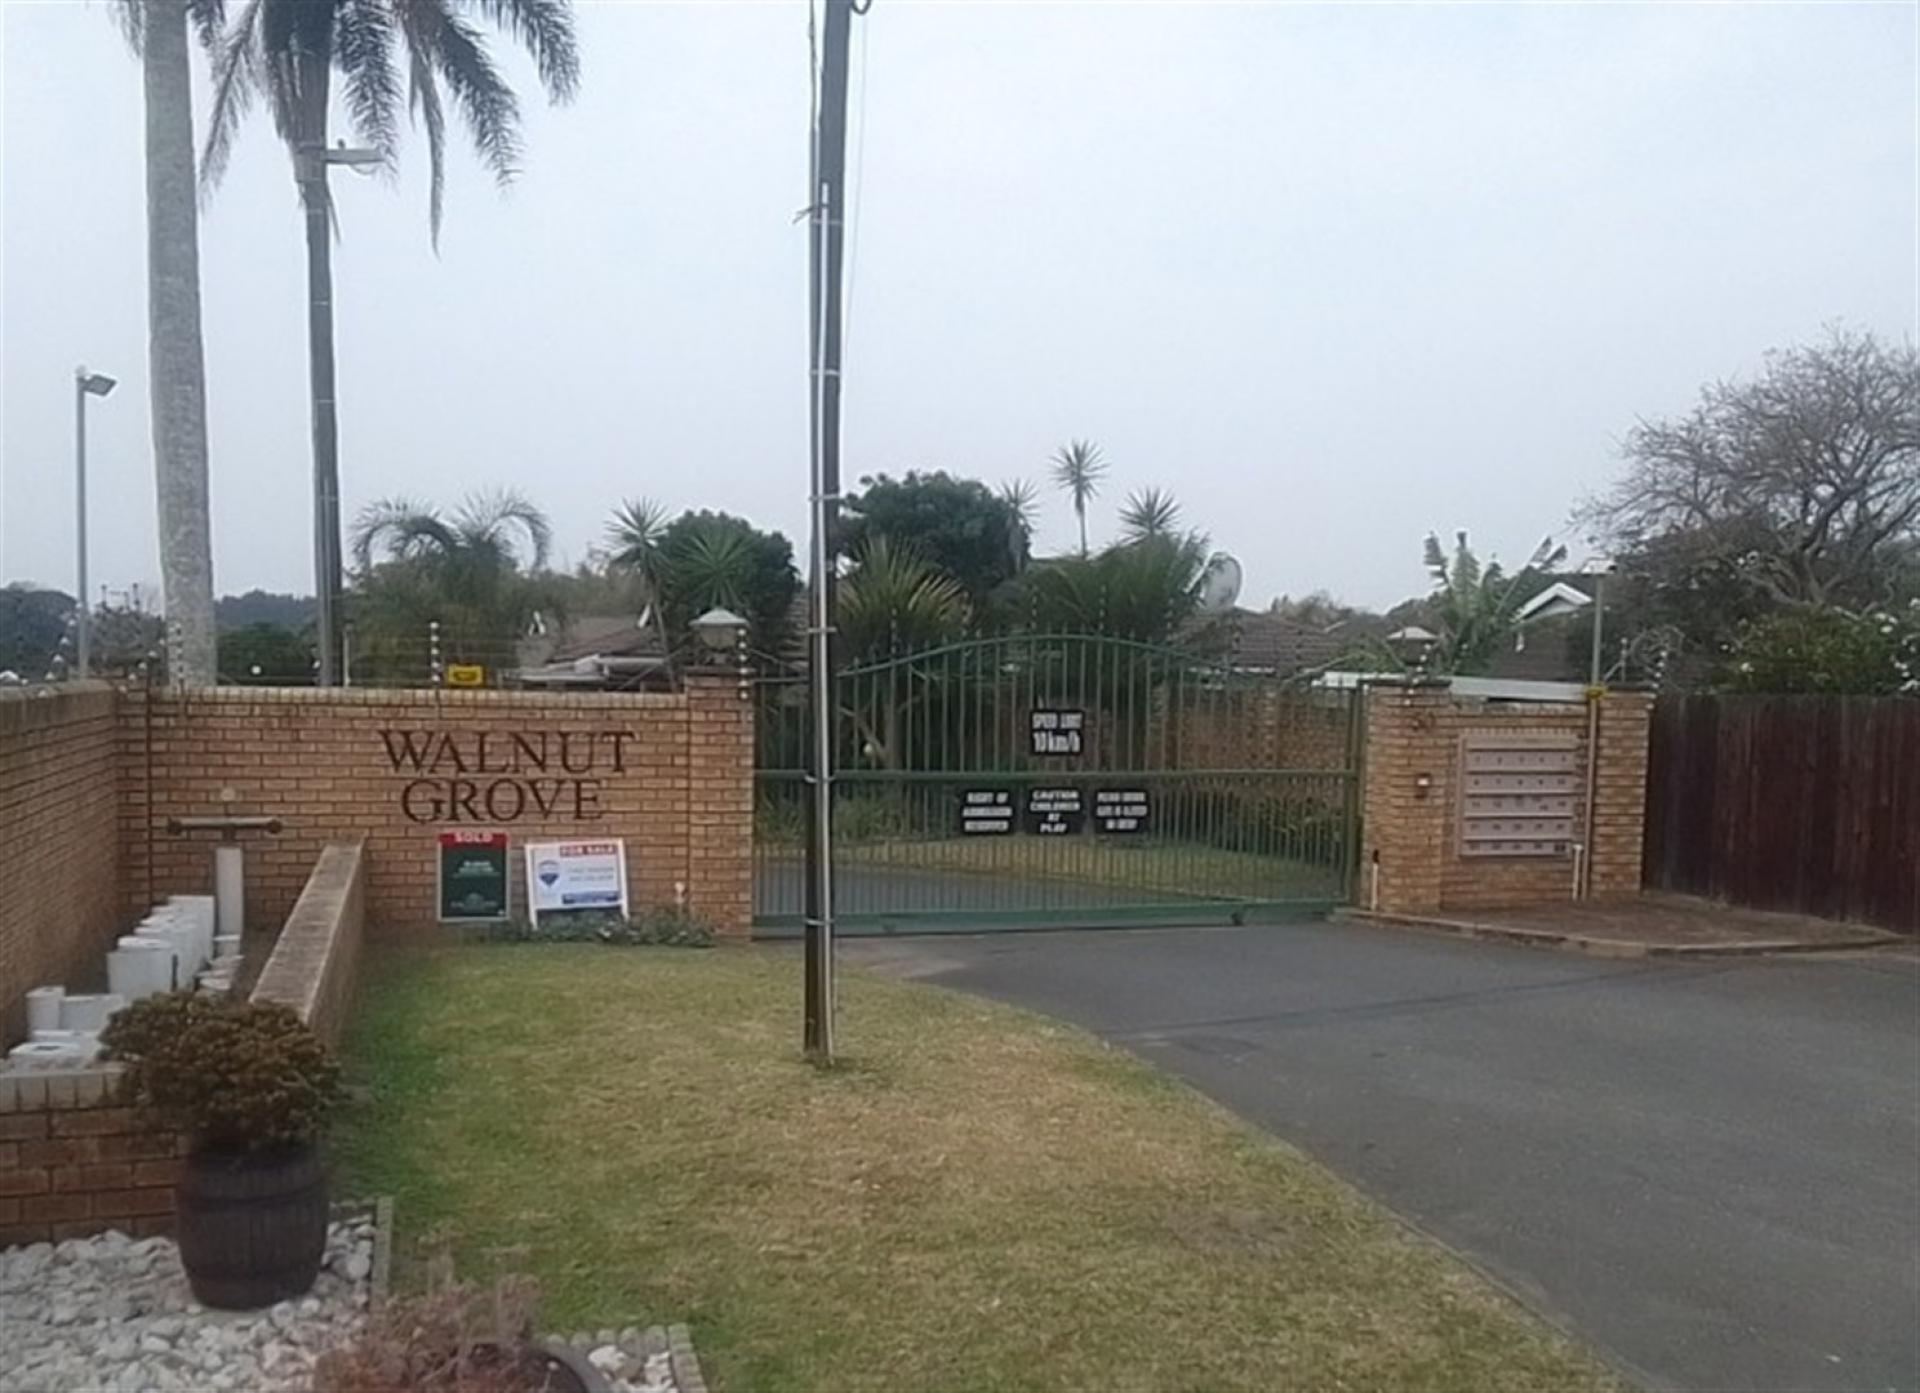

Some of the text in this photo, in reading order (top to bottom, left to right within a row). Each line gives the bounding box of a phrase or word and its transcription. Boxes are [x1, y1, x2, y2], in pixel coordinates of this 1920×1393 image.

[378, 730, 636, 774] WALNUT
[402, 778, 602, 824] GROVE
[1032, 790, 1079, 800] CAUTION
[454, 831, 493, 843] SOLD
[586, 845, 616, 855] SALE
